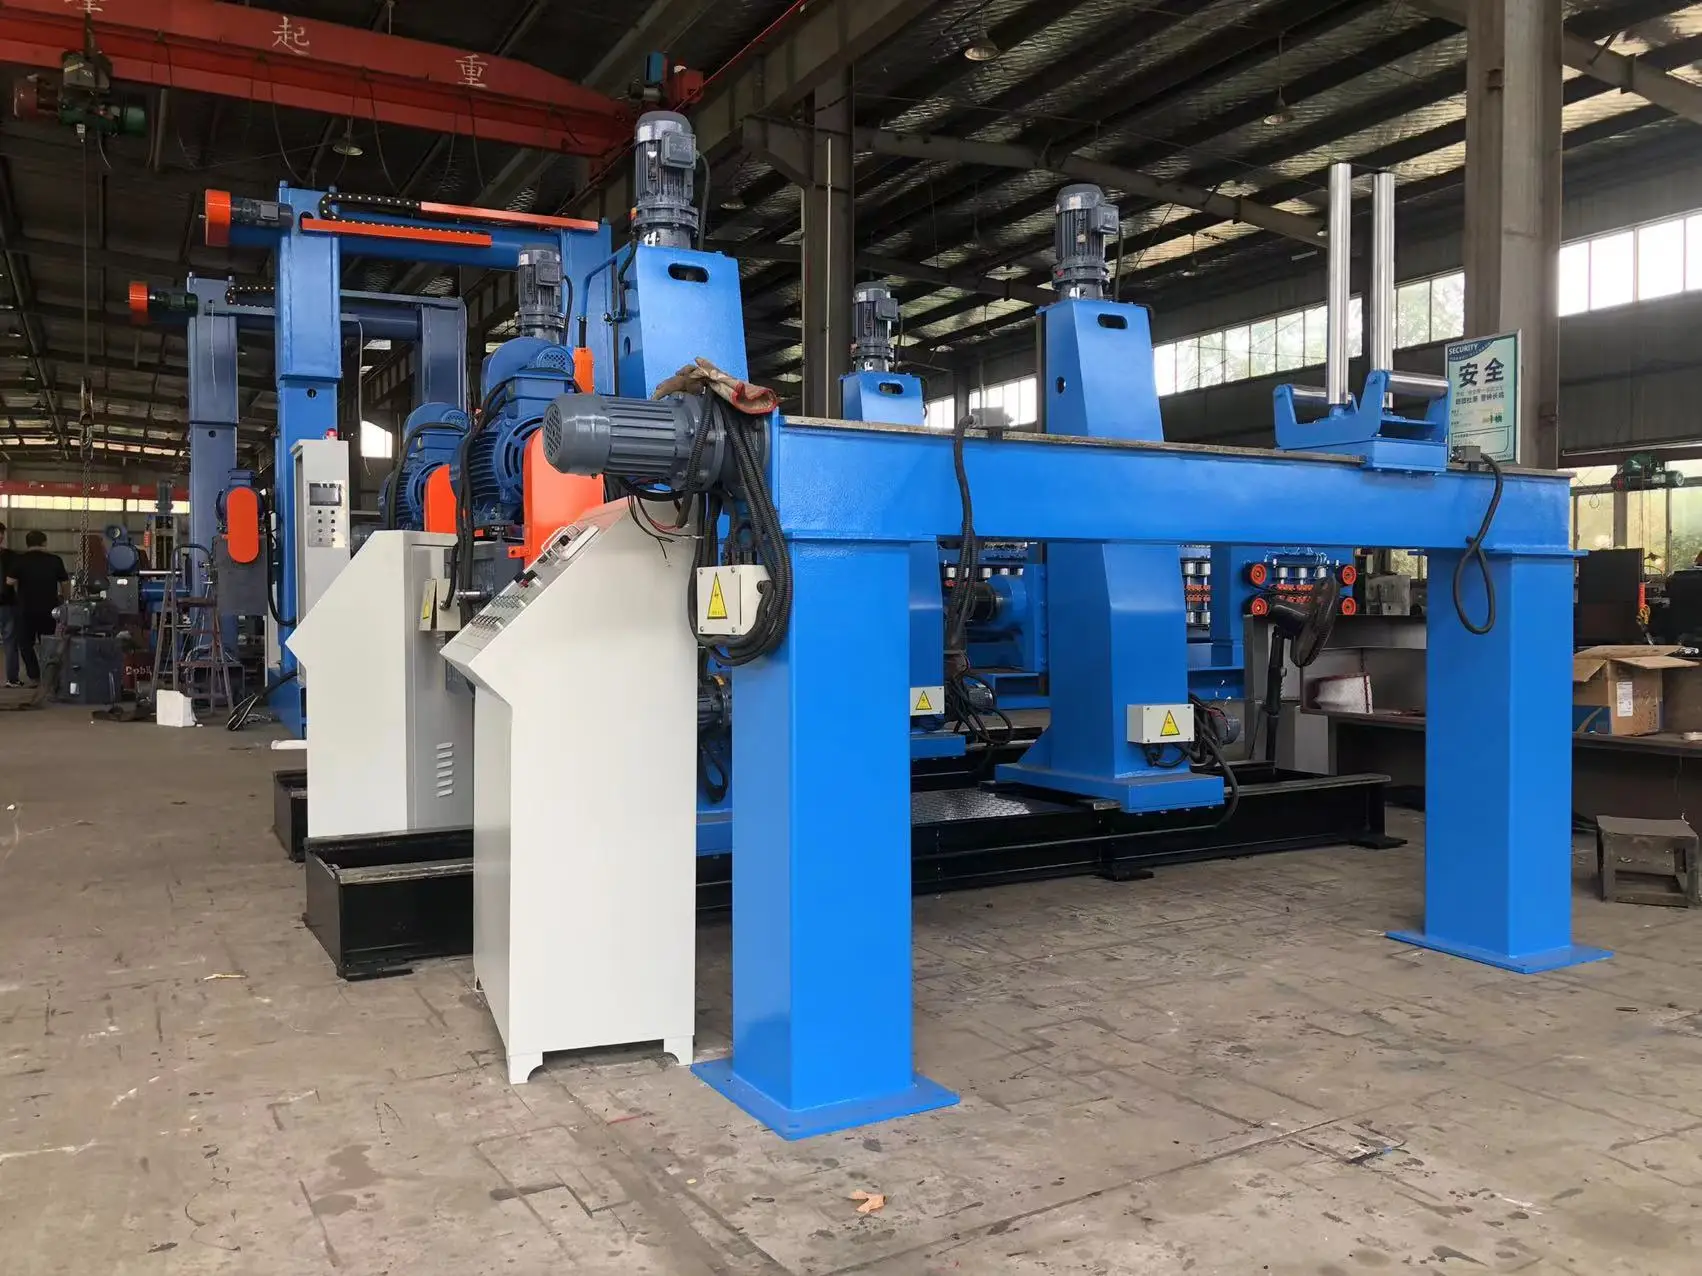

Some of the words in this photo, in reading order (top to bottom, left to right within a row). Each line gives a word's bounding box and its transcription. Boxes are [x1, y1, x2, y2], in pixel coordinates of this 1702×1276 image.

[271, 15, 310, 56] 起
[455, 53, 488, 88] 重
[1448, 343, 1479, 355] SECURITY
[1459, 357, 1505, 388] 安全
